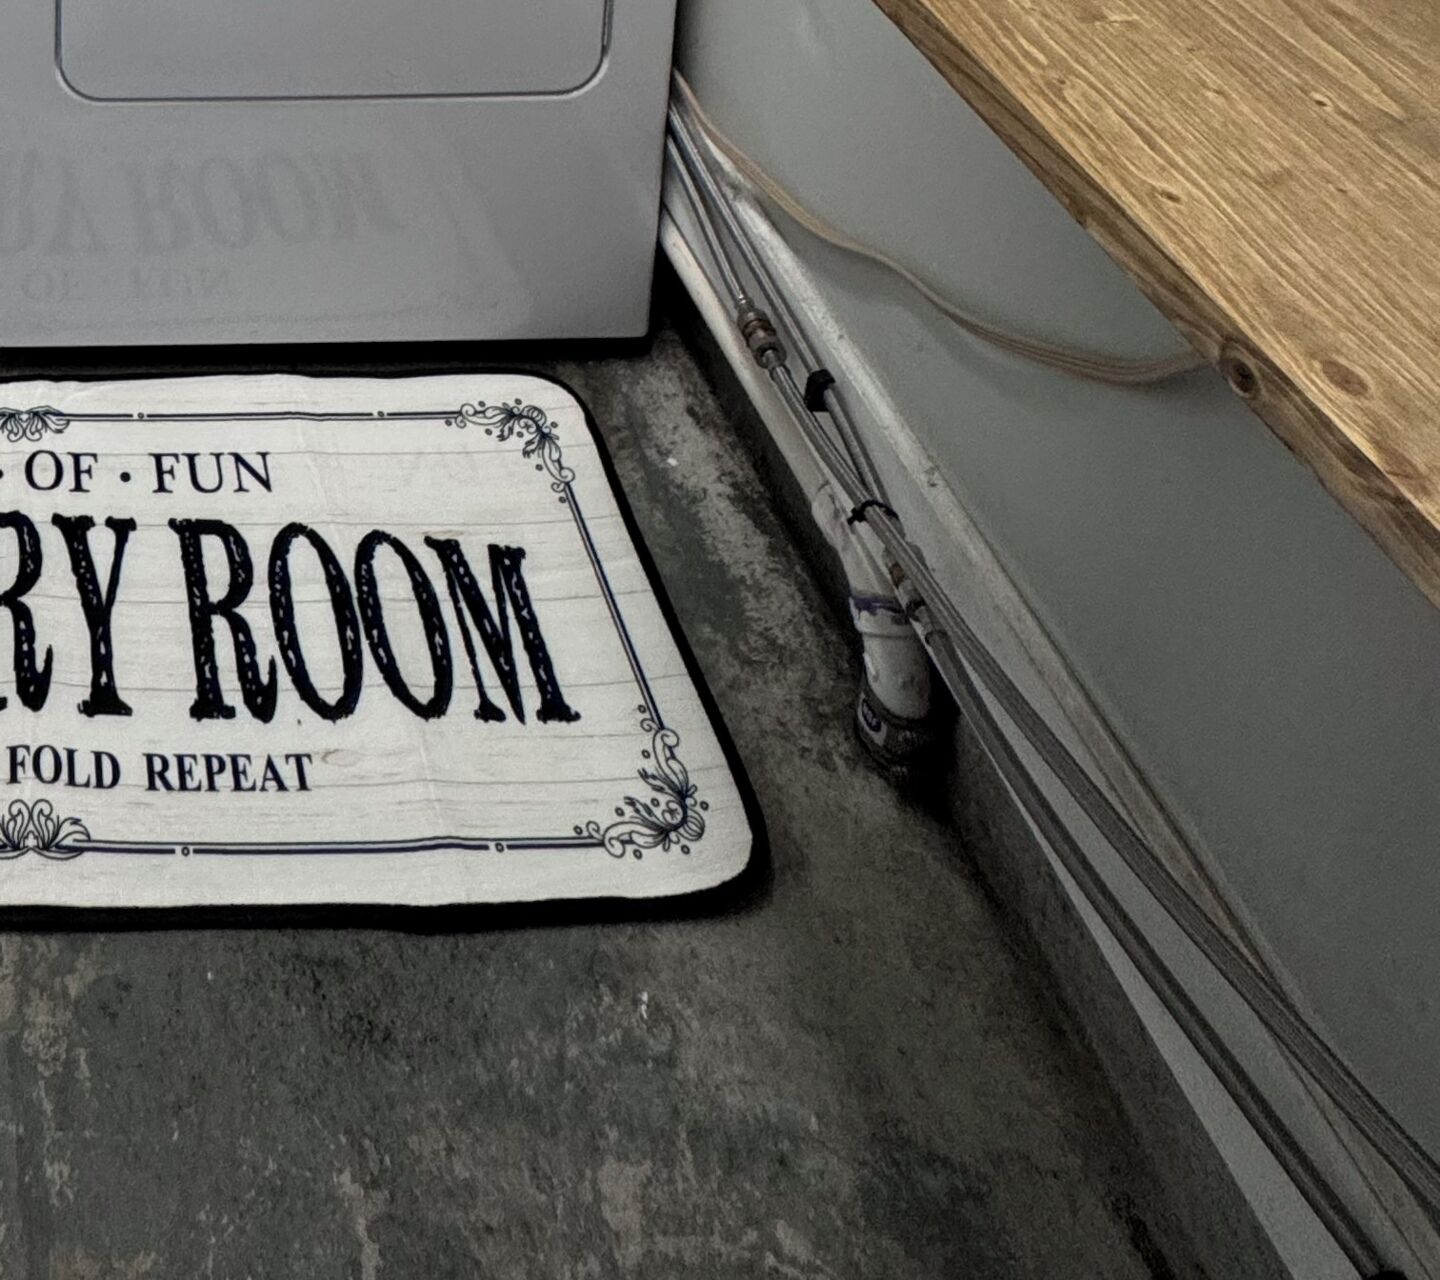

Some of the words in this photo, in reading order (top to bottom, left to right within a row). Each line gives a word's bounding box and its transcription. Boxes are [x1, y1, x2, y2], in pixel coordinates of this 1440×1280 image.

[25, 452, 98, 493] OF
[151, 452, 273, 493] FUN
[168, 517, 581, 725] ROOM
[7, 745, 121, 791] FOLD
[143, 753, 313, 794] REPEAT
